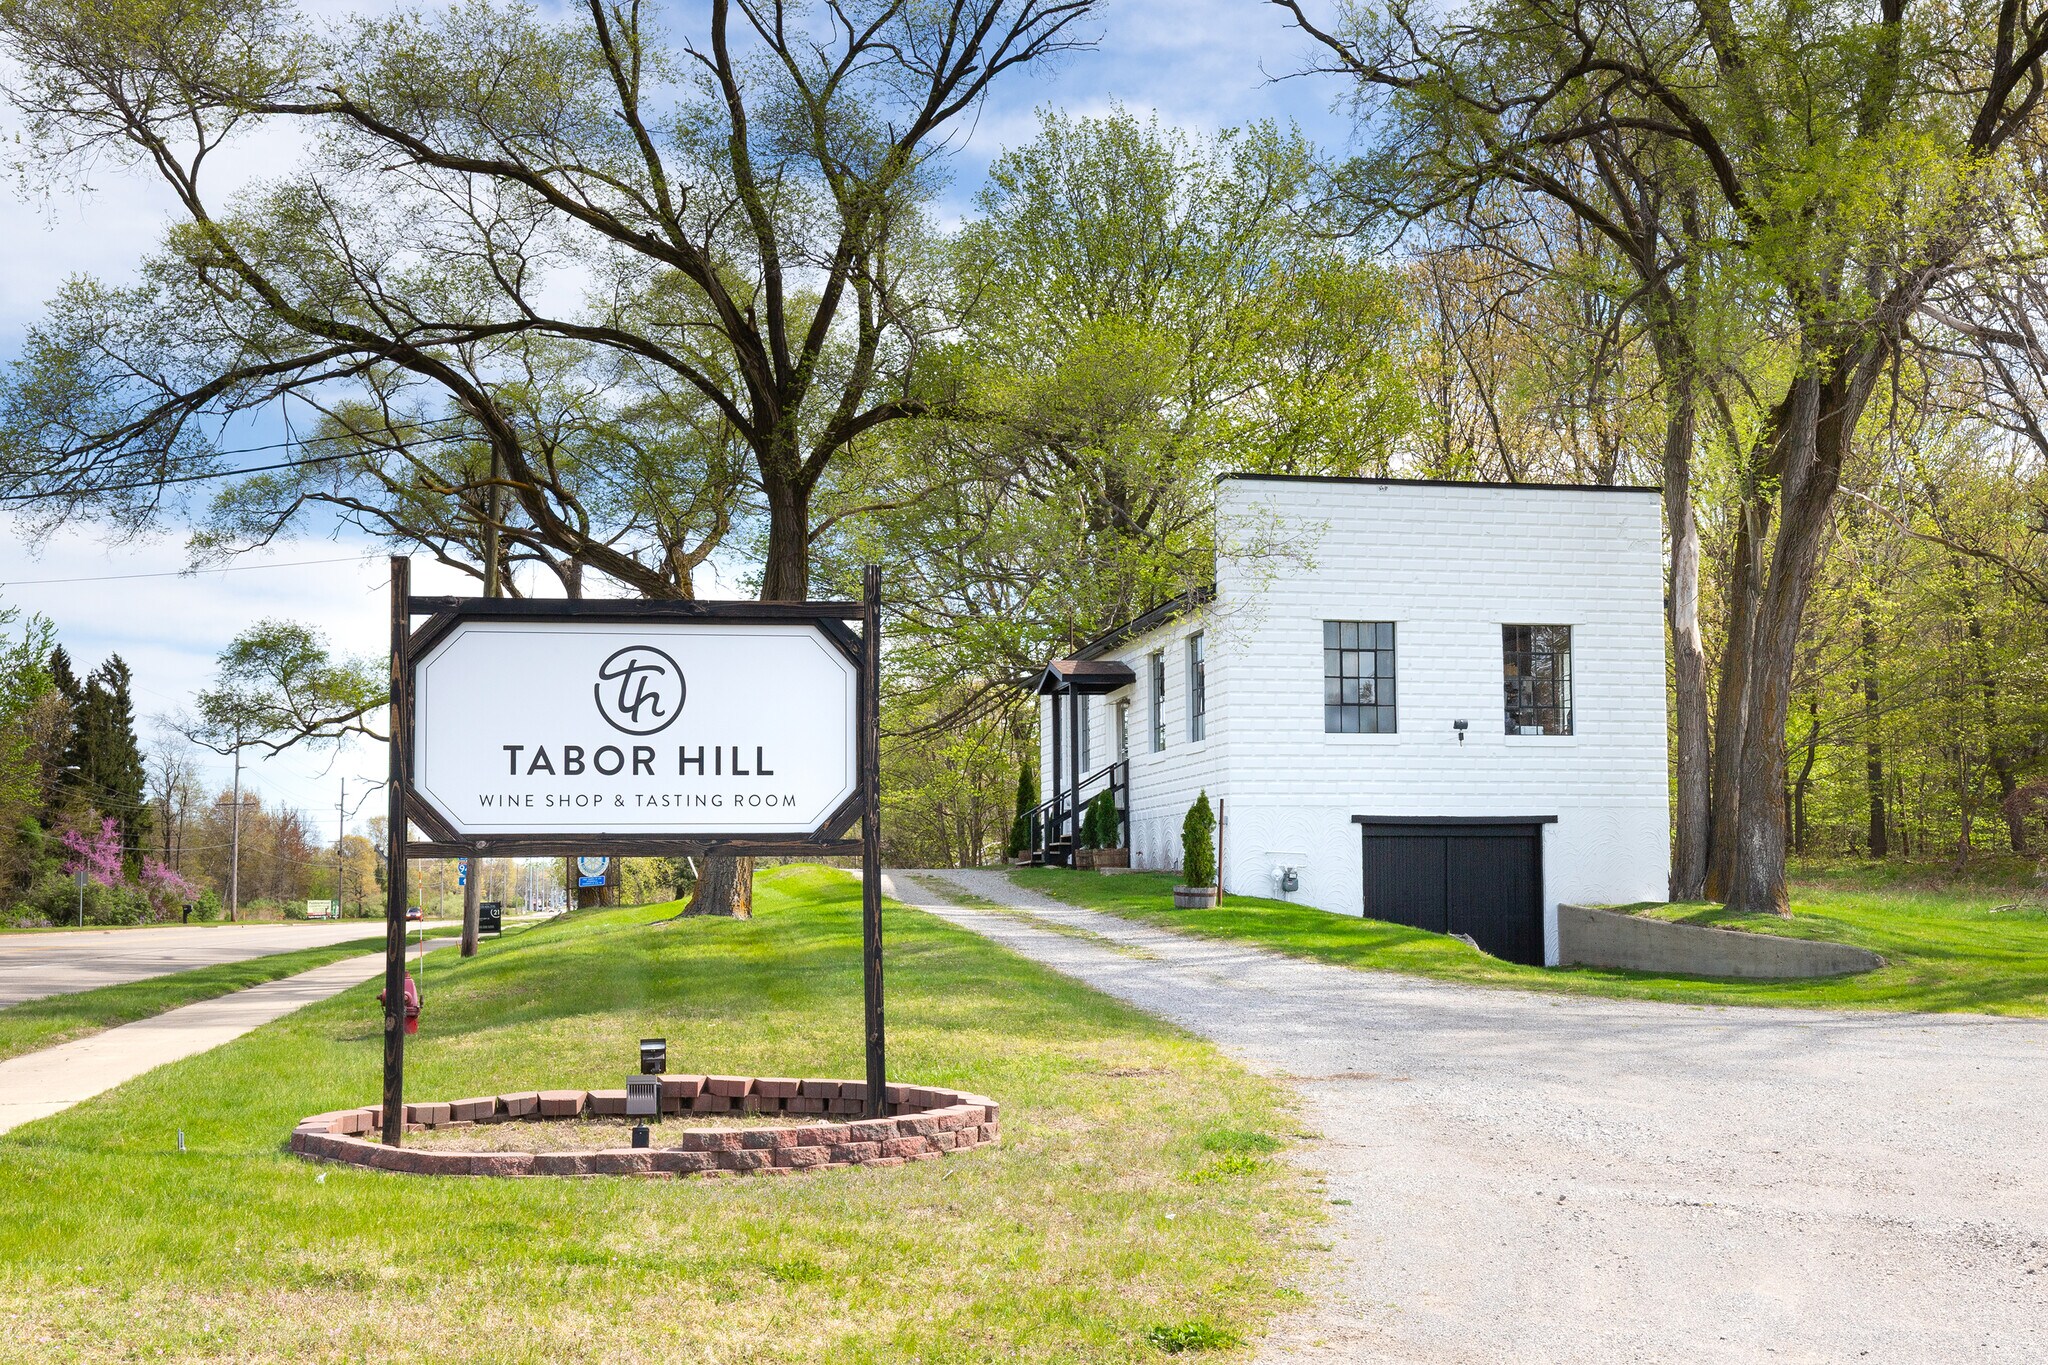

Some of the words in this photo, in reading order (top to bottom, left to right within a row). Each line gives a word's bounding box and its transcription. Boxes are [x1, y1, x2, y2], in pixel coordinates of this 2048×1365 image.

[503, 745, 655, 775] TABOR
[679, 745, 774, 776] HILL
[479, 794, 534, 807] WINE
[546, 794, 603, 807] SHOP
[614, 794, 625, 807] &
[635, 794, 723, 807] TASTING
[735, 794, 796, 807] ROOM
